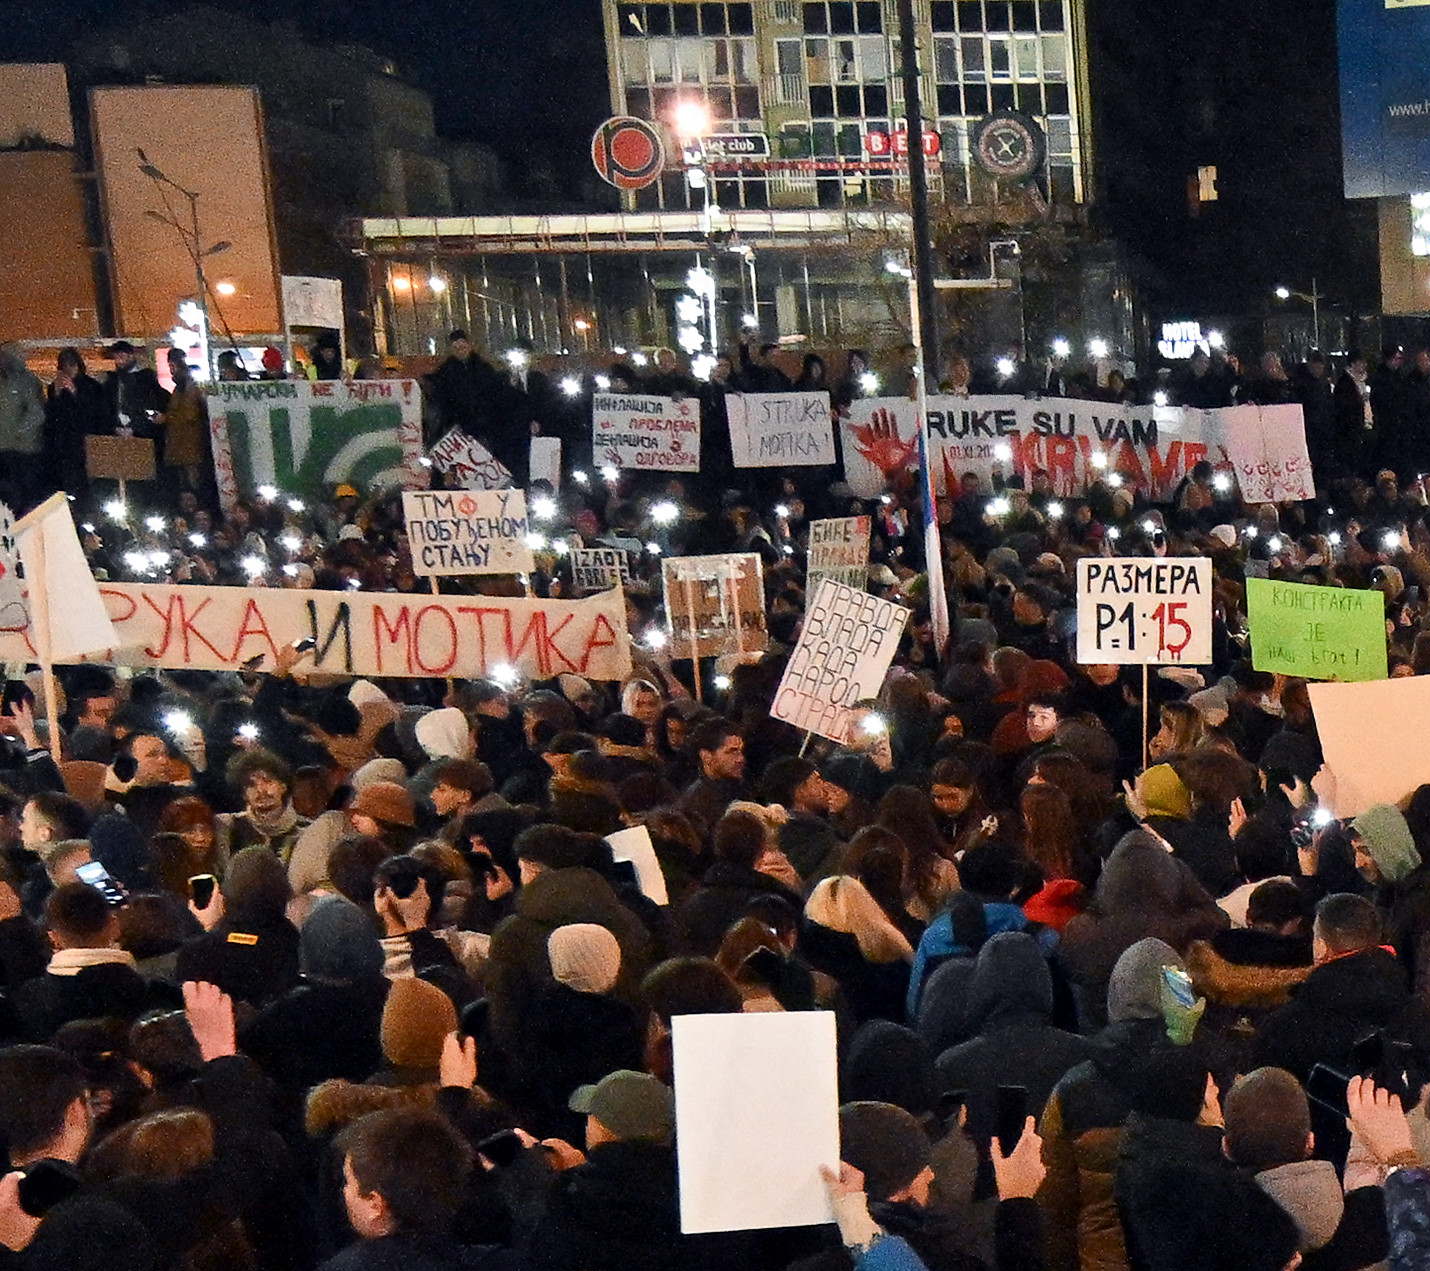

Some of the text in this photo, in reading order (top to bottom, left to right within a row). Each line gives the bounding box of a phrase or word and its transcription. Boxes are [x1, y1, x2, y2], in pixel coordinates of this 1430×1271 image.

[728, 138, 755, 150] club
[311, 382, 332, 397] НЕ
[760, 398, 829, 424] STRUKA
[926, 410, 1158, 446] RUKE SU VAM
[498, 493, 511, 517] У
[410, 516, 528, 545] ПОБУЂЕНОМ
[421, 543, 491, 568] СТАЊУ
[1086, 564, 1201, 595] РАЗМЕРА
[818, 580, 908, 637] ПРАВДА
[306, 598, 354, 673] И
[372, 603, 616, 675] МОТИКА
[807, 606, 884, 657] ВЛАДА
[795, 638, 858, 679] КАДА
[785, 665, 861, 709] НАРОД
[775, 688, 850, 744] СТРАД
